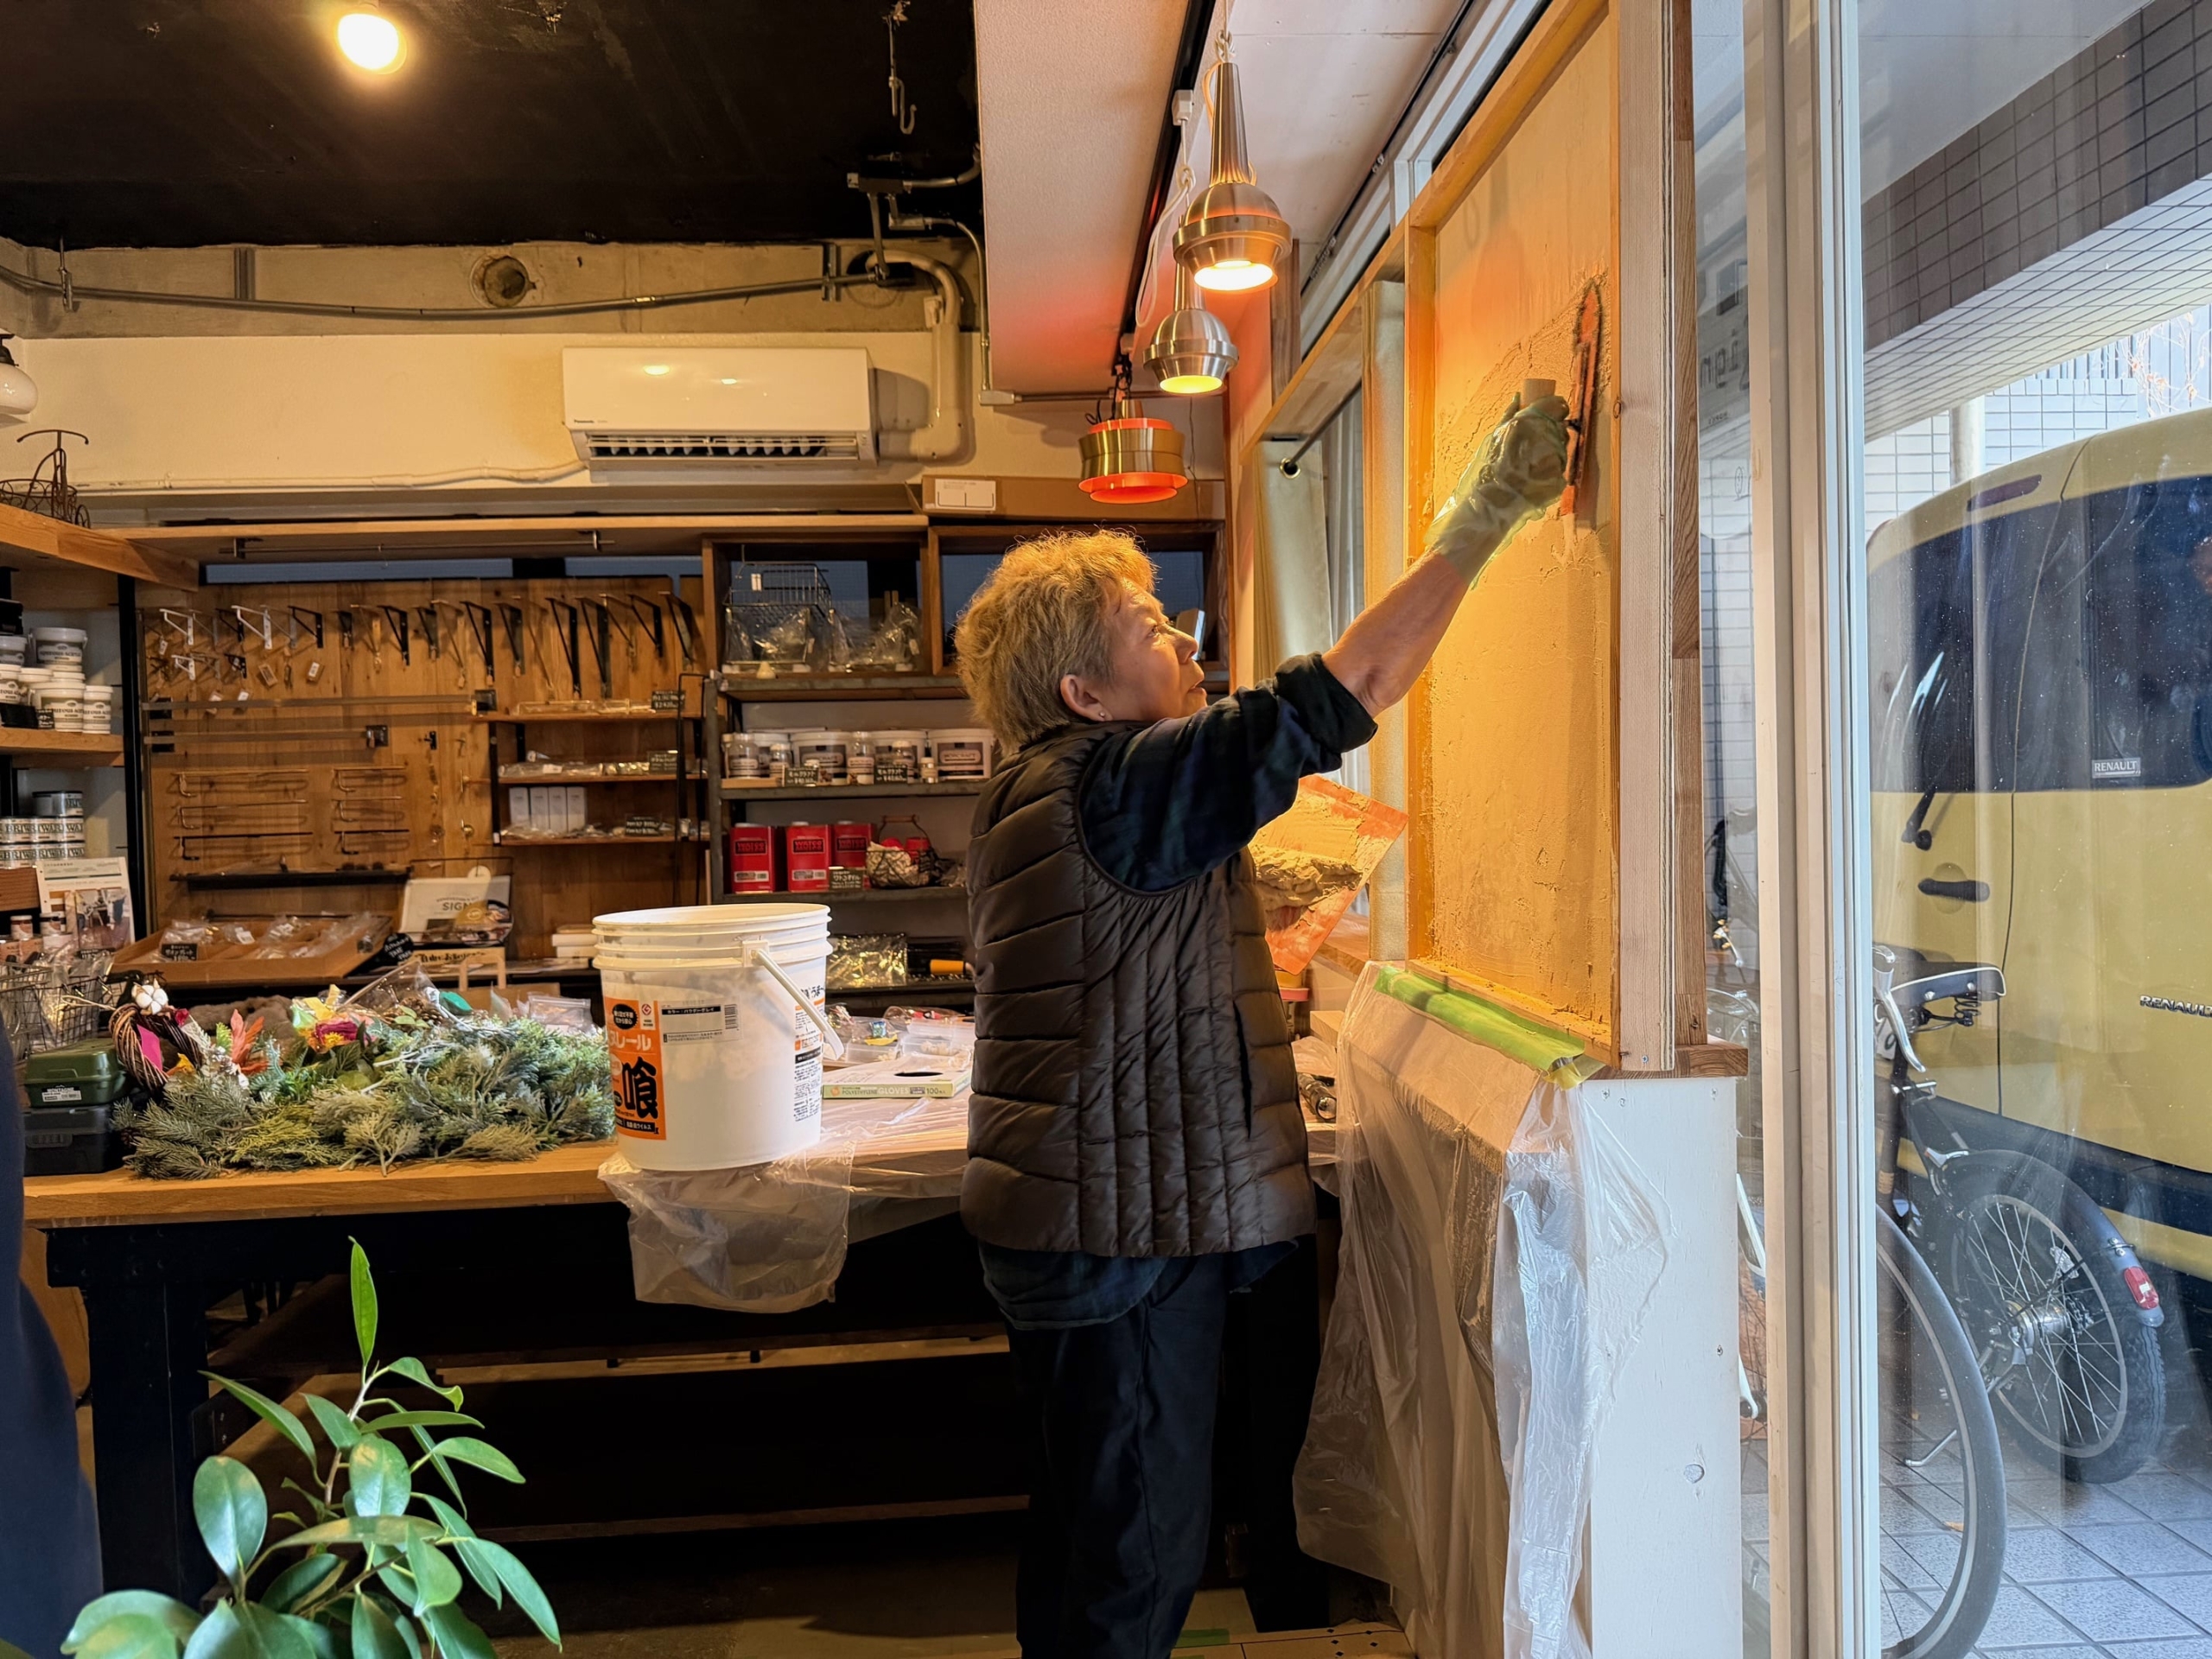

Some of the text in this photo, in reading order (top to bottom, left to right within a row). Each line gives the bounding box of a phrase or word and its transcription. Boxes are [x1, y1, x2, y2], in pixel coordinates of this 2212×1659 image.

[2094, 760, 2138, 772] RENAULT
[621, 1056, 658, 1119] 喰
[878, 1086, 909, 1096] GLOVES
